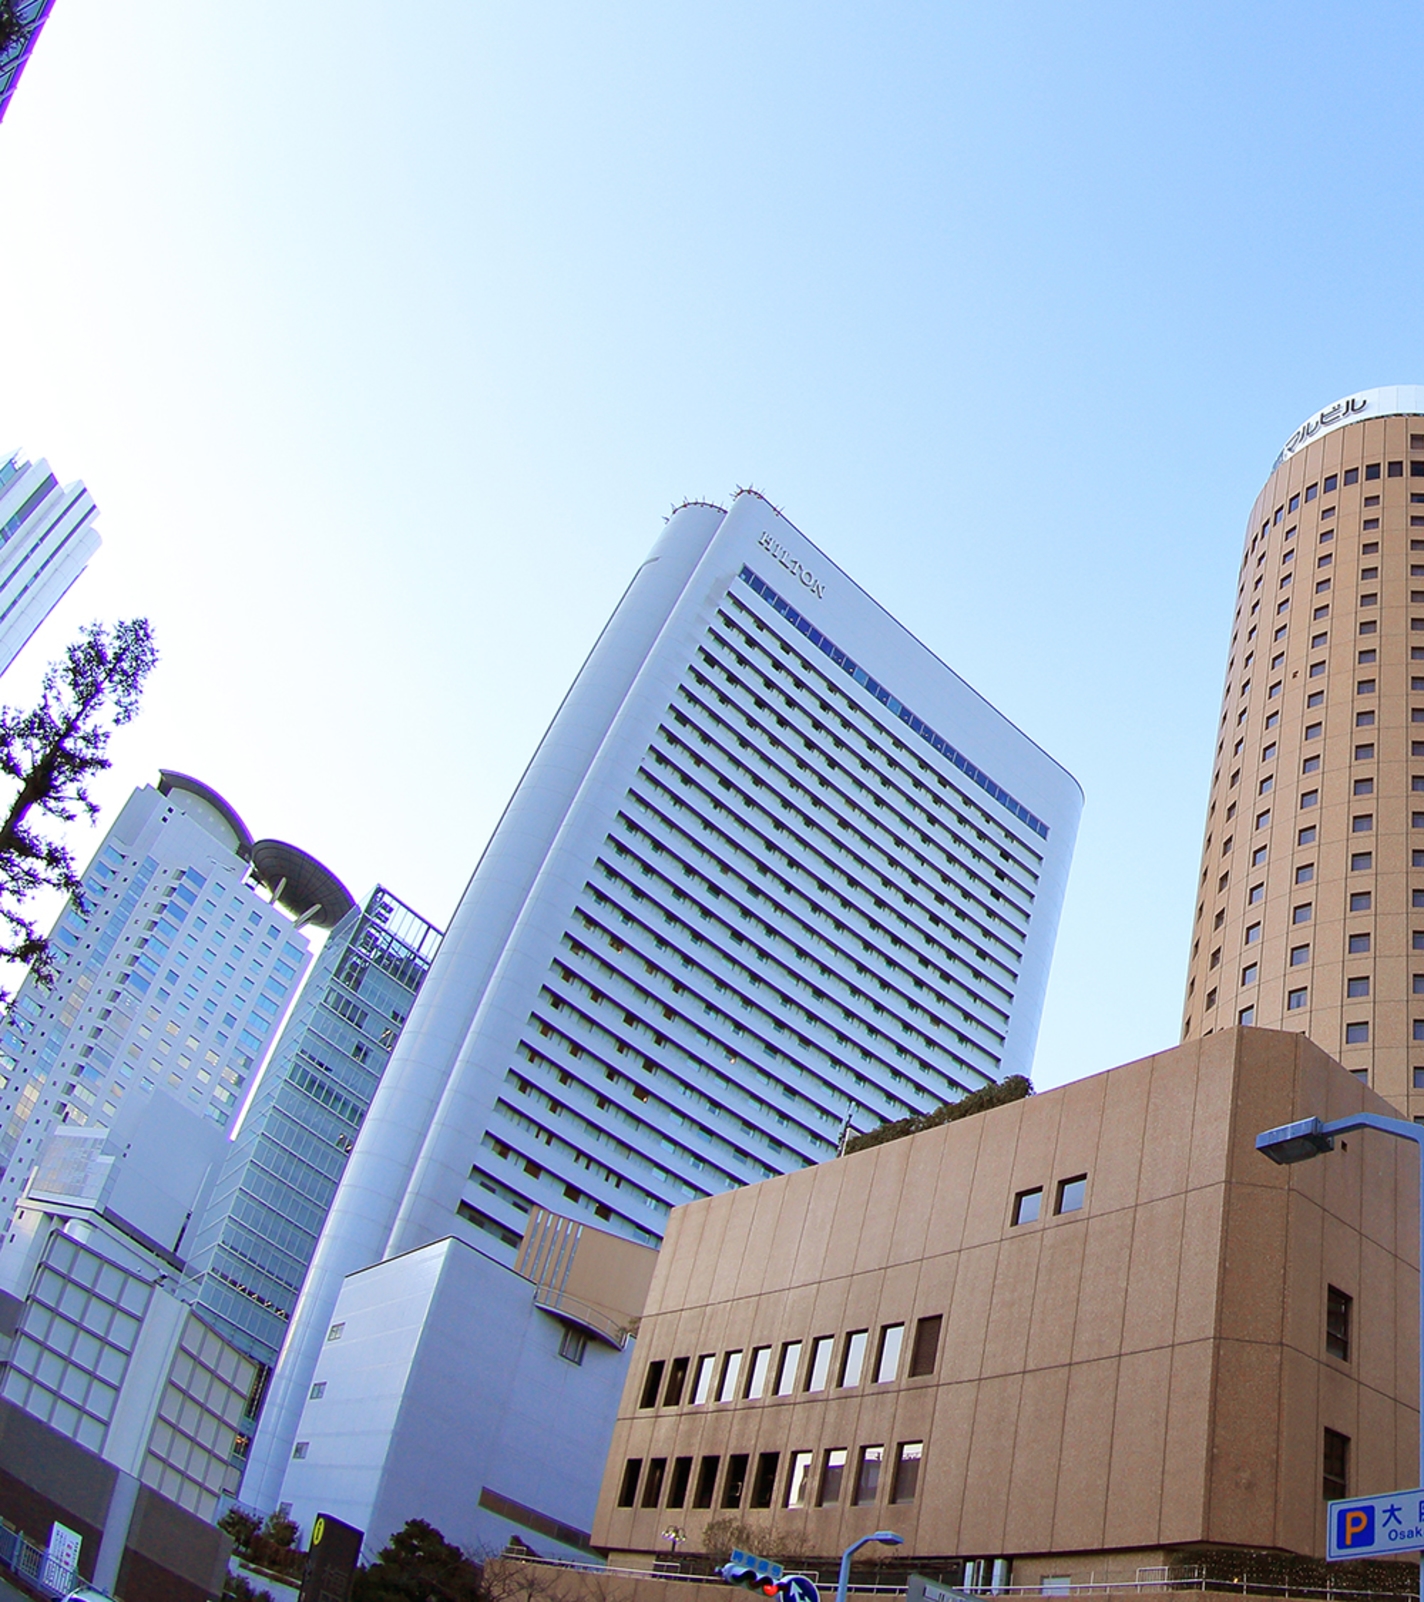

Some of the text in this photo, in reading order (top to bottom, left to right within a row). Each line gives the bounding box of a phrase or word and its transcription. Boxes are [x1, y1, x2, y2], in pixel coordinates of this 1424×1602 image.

[1285, 398, 1367, 454] マルビル
[758, 531, 825, 599] HILTON
[1345, 1510, 1368, 1546] P
